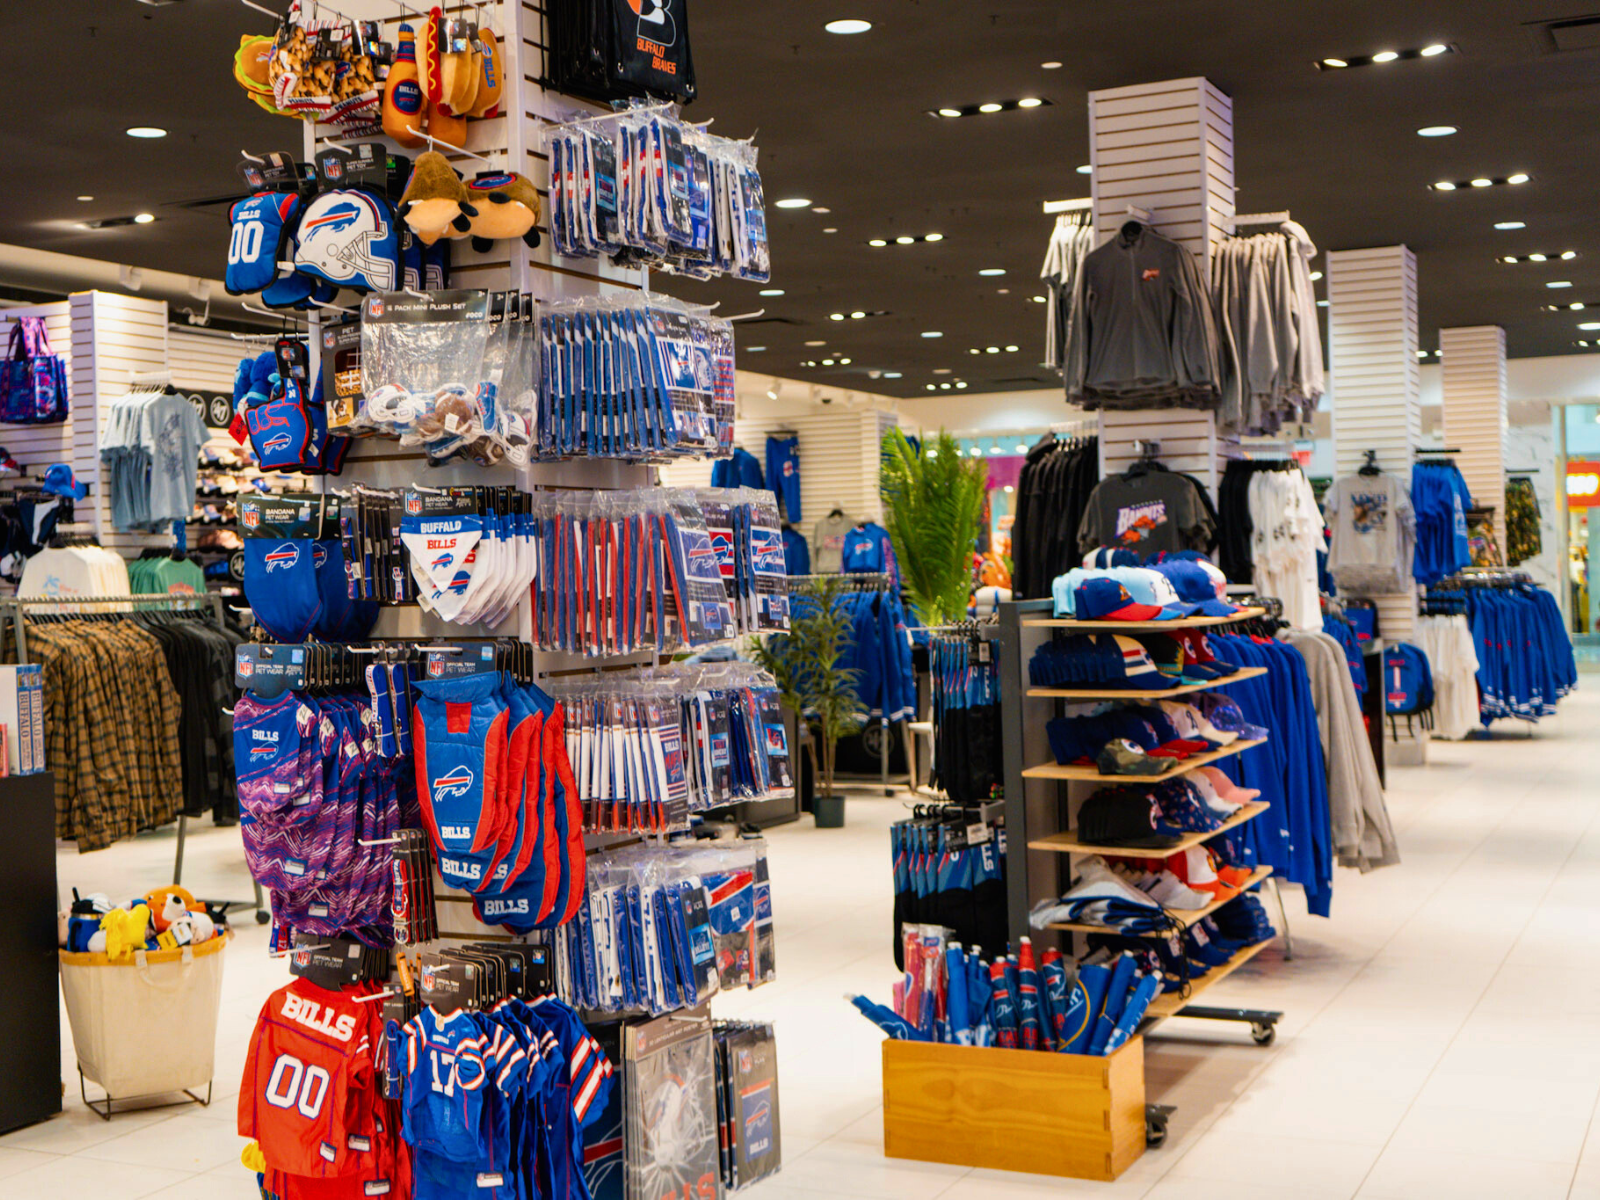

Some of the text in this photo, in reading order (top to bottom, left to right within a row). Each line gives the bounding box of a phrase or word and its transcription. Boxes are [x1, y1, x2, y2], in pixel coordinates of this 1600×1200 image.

[637, 38, 665, 58] BUFFALO
[483, 57, 496, 88] BILLS
[652, 56, 676, 75] BRAVES
[228, 220, 264, 266] 00
[408, 500, 422, 513] NFL
[244, 511, 260, 527] NFL
[420, 521, 462, 534] BUFFALO
[427, 538, 457, 550] BILLS
[240, 662, 254, 676] NFL
[430, 661, 444, 675] NFL
[19, 692, 30, 738] BUFFALO
[32, 691, 43, 736] BUFFALO
[252, 729, 279, 742] BILLS
[441, 826, 471, 839] BILLS
[441, 857, 481, 880] BILLS
[484, 898, 529, 916] BILLS
[297, 951, 311, 965] NFL
[280, 990, 357, 1043] BILLS
[429, 1049, 457, 1098] 17
[264, 1052, 331, 1121] 00
